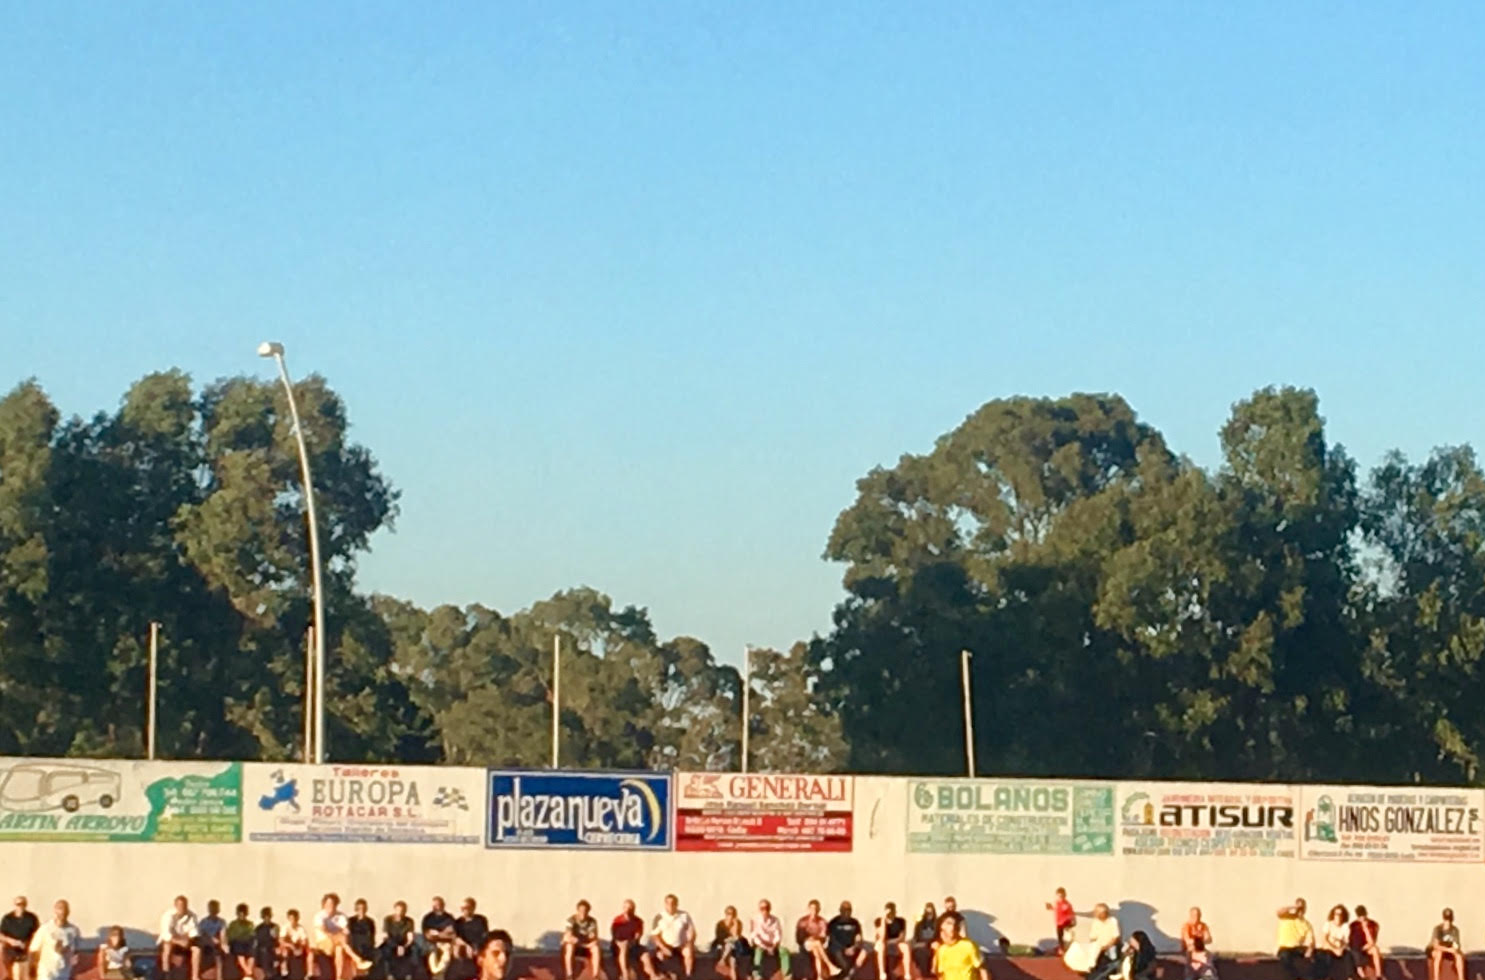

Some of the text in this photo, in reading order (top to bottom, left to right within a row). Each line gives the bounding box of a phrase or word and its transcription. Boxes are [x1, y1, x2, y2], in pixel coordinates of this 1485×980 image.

[312, 779, 420, 805] EUROPA
[729, 776, 846, 801] GENERALI
[312, 806, 387, 817] ROTACAR
[496, 776, 645, 841] plazanueva
[1339, 806, 1465, 834] HNOS GONZALEZ
